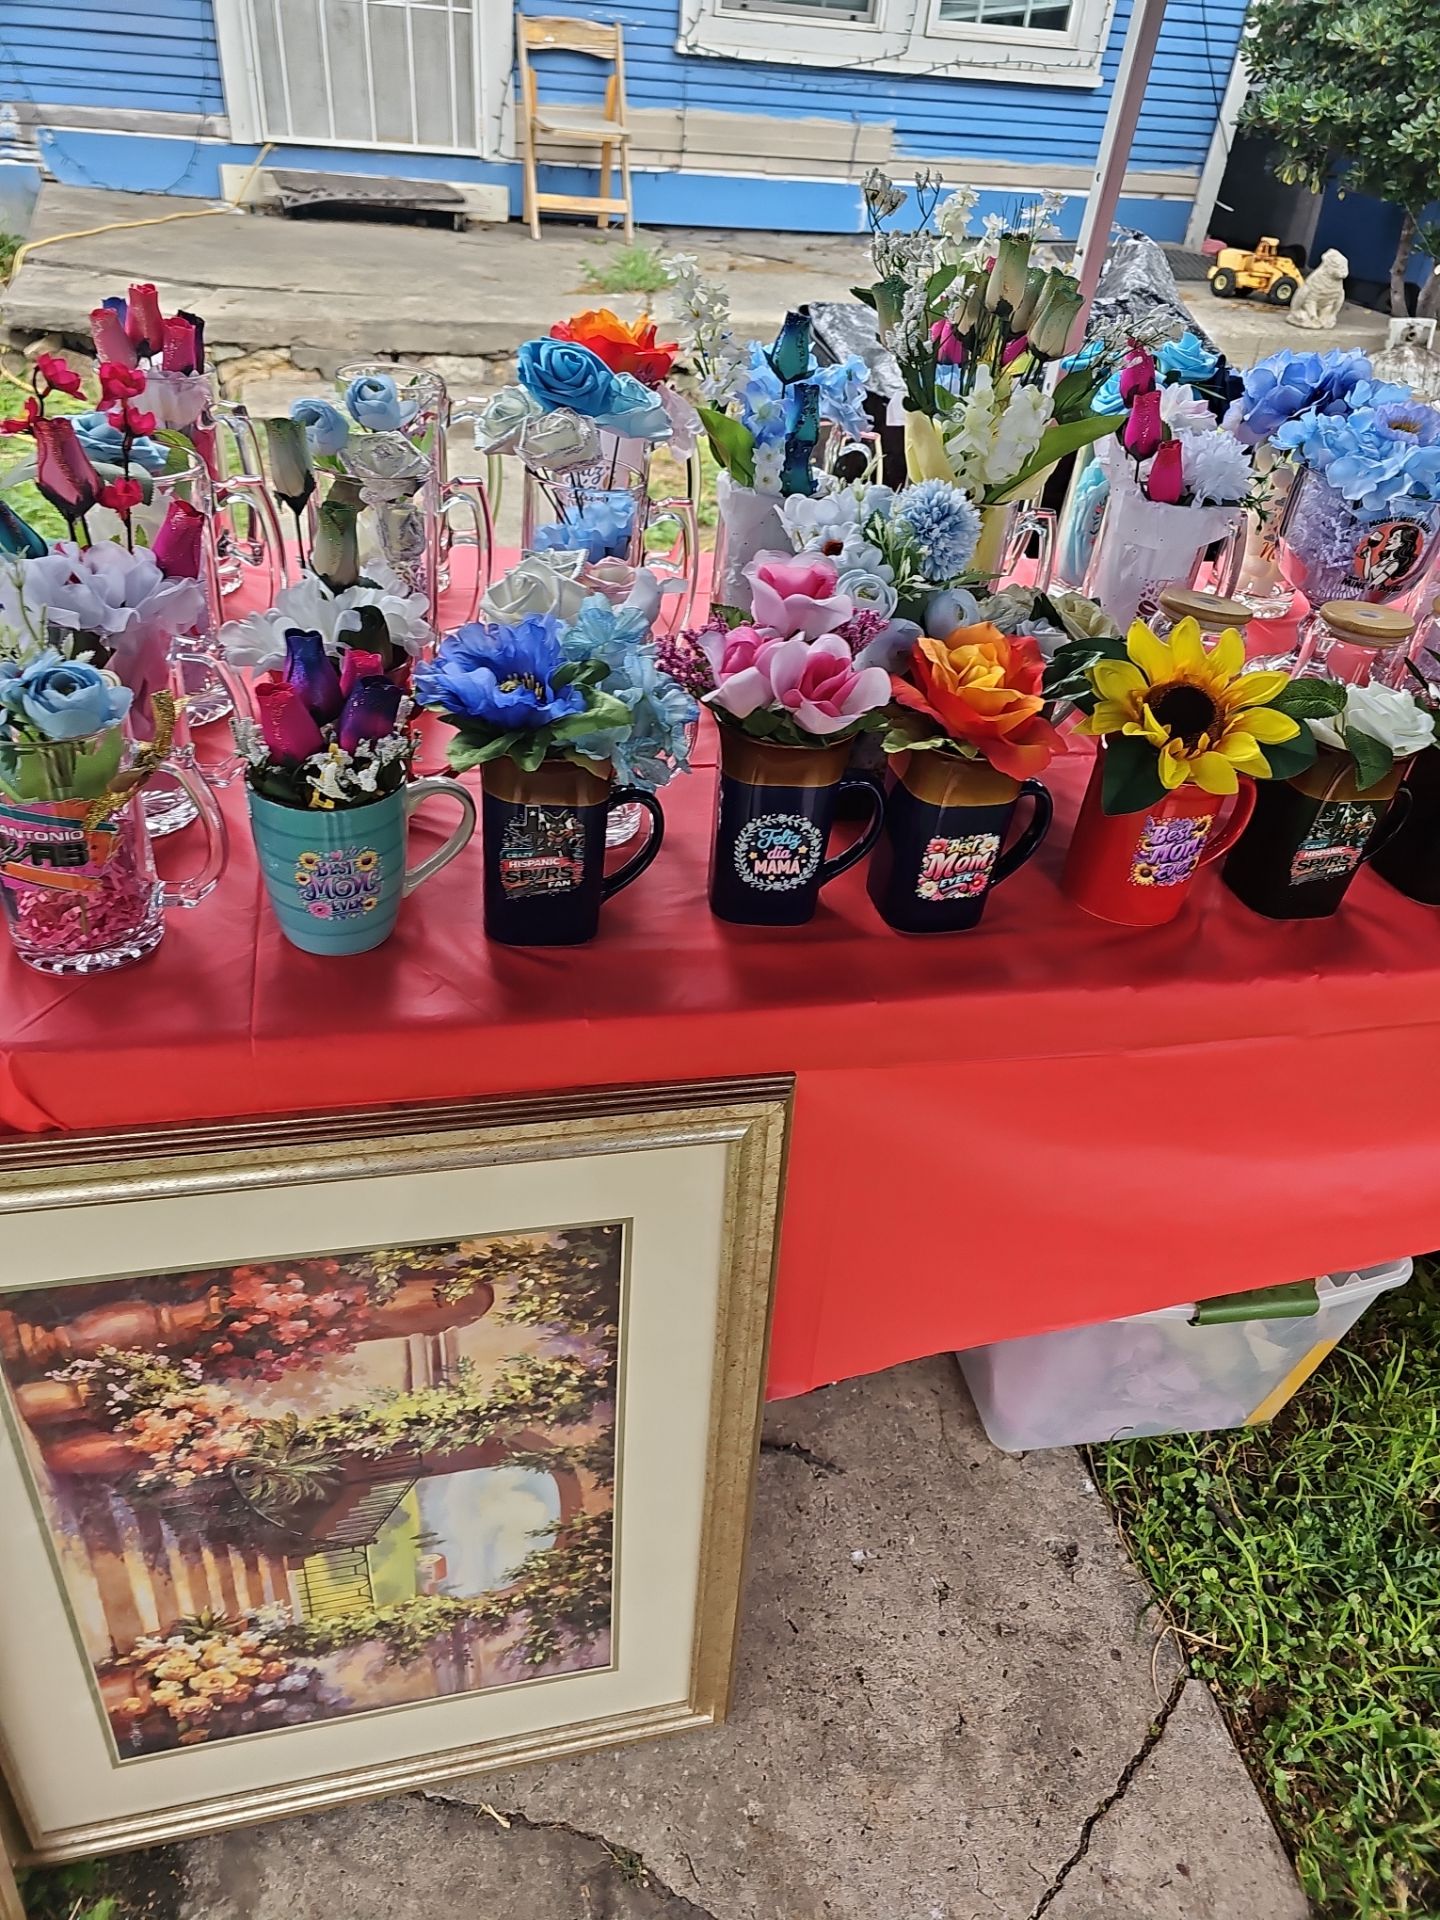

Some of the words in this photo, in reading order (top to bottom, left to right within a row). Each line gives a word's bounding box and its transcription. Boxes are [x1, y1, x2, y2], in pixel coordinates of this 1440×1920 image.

[0, 825, 85, 842] ANTONIO
[757, 828, 802, 851] Feliz
[1150, 824, 1193, 845] Best
[1304, 846, 1345, 858] HISPANIC
[317, 859, 355, 877] BEST
[508, 857, 561, 869] HISPANIC
[753, 855, 801, 875] MAMÁ
[1296, 853, 1353, 871] SPURS
[1326, 865, 1347, 874] FAN
[504, 866, 574, 884] SPURS
[939, 873, 974, 889] EVER
[303, 870, 382, 901] MOM
[547, 880, 571, 889] FAN
